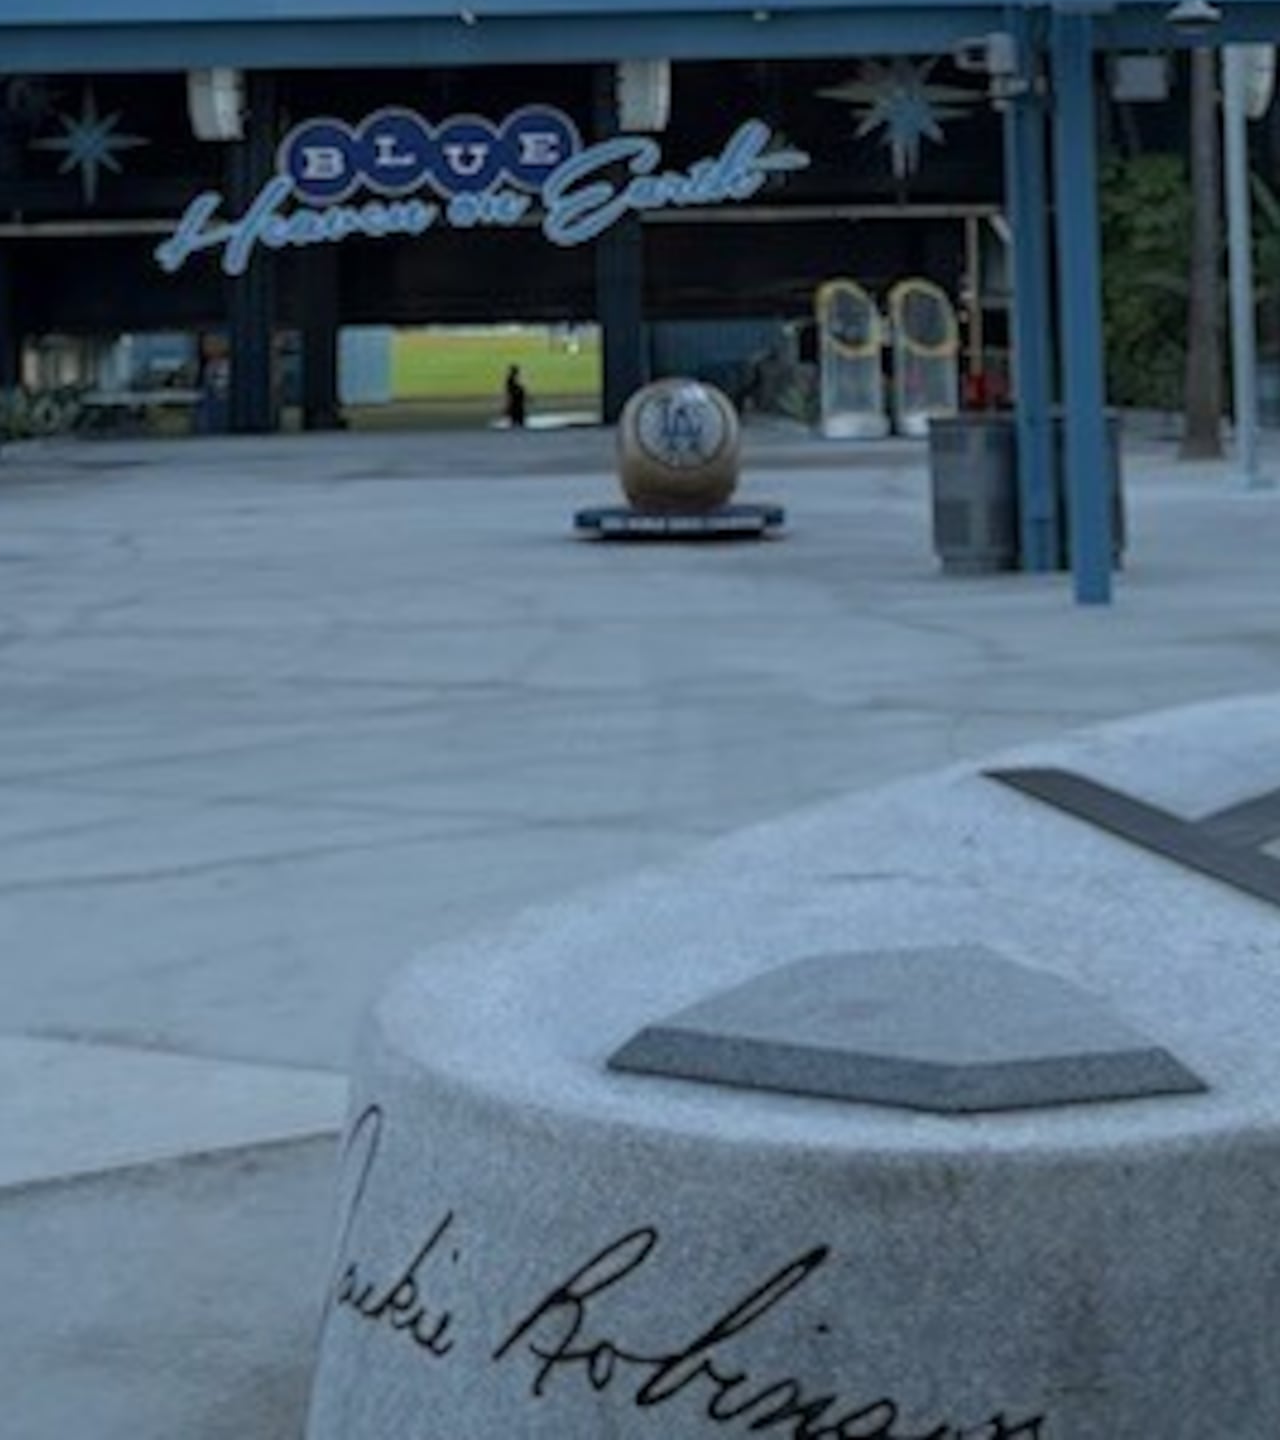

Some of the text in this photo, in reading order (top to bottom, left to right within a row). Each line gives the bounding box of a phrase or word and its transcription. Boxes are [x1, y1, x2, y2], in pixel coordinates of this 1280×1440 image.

[153, 117, 812, 277] Heaven on Earth
[301, 130, 563, 182] BLUE
